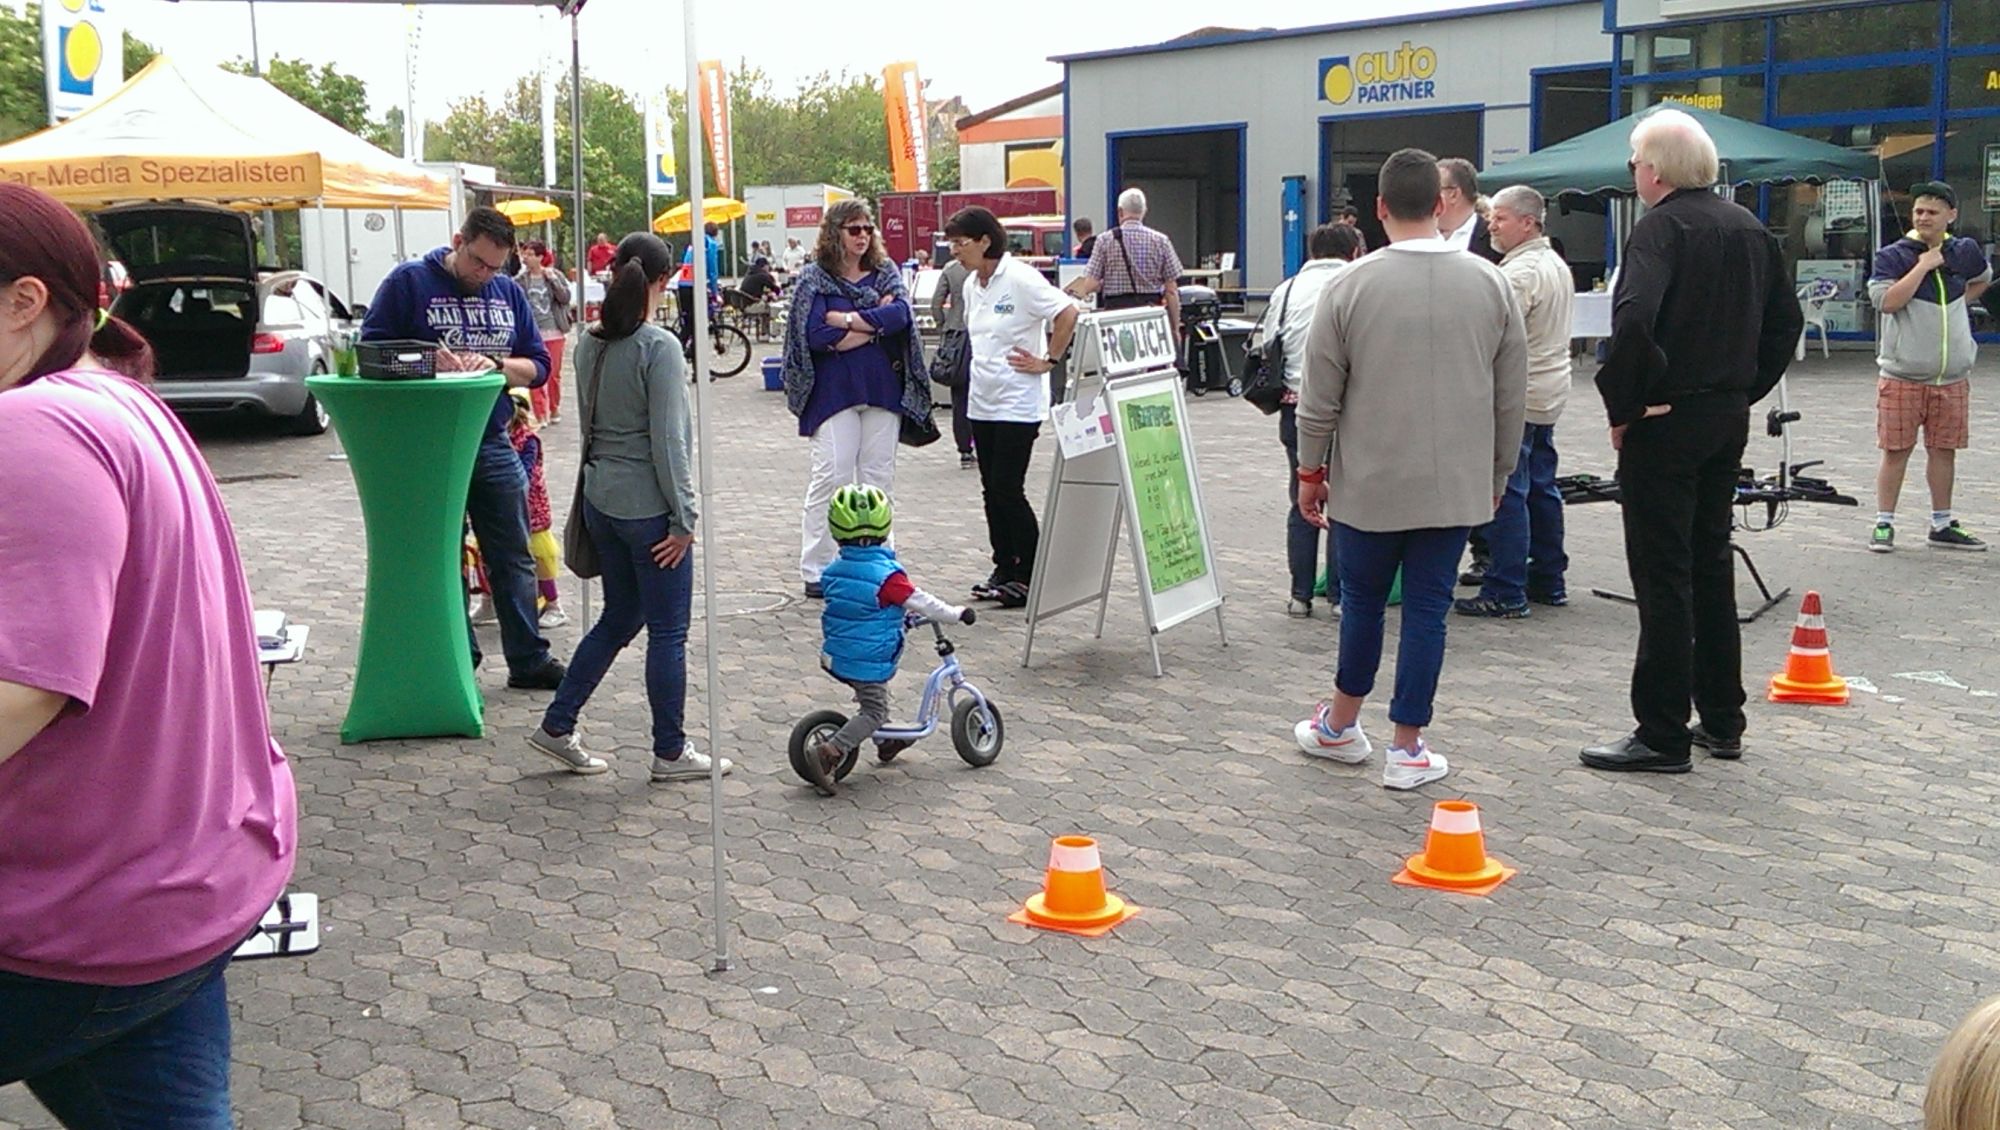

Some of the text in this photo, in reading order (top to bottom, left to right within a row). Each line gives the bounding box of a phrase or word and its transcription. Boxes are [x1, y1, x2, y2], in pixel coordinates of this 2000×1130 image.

[1356, 41, 1437, 84] auto
[1358, 81, 1435, 103] PARTNER
[0, 160, 306, 187] ar-Media Spezialisten
